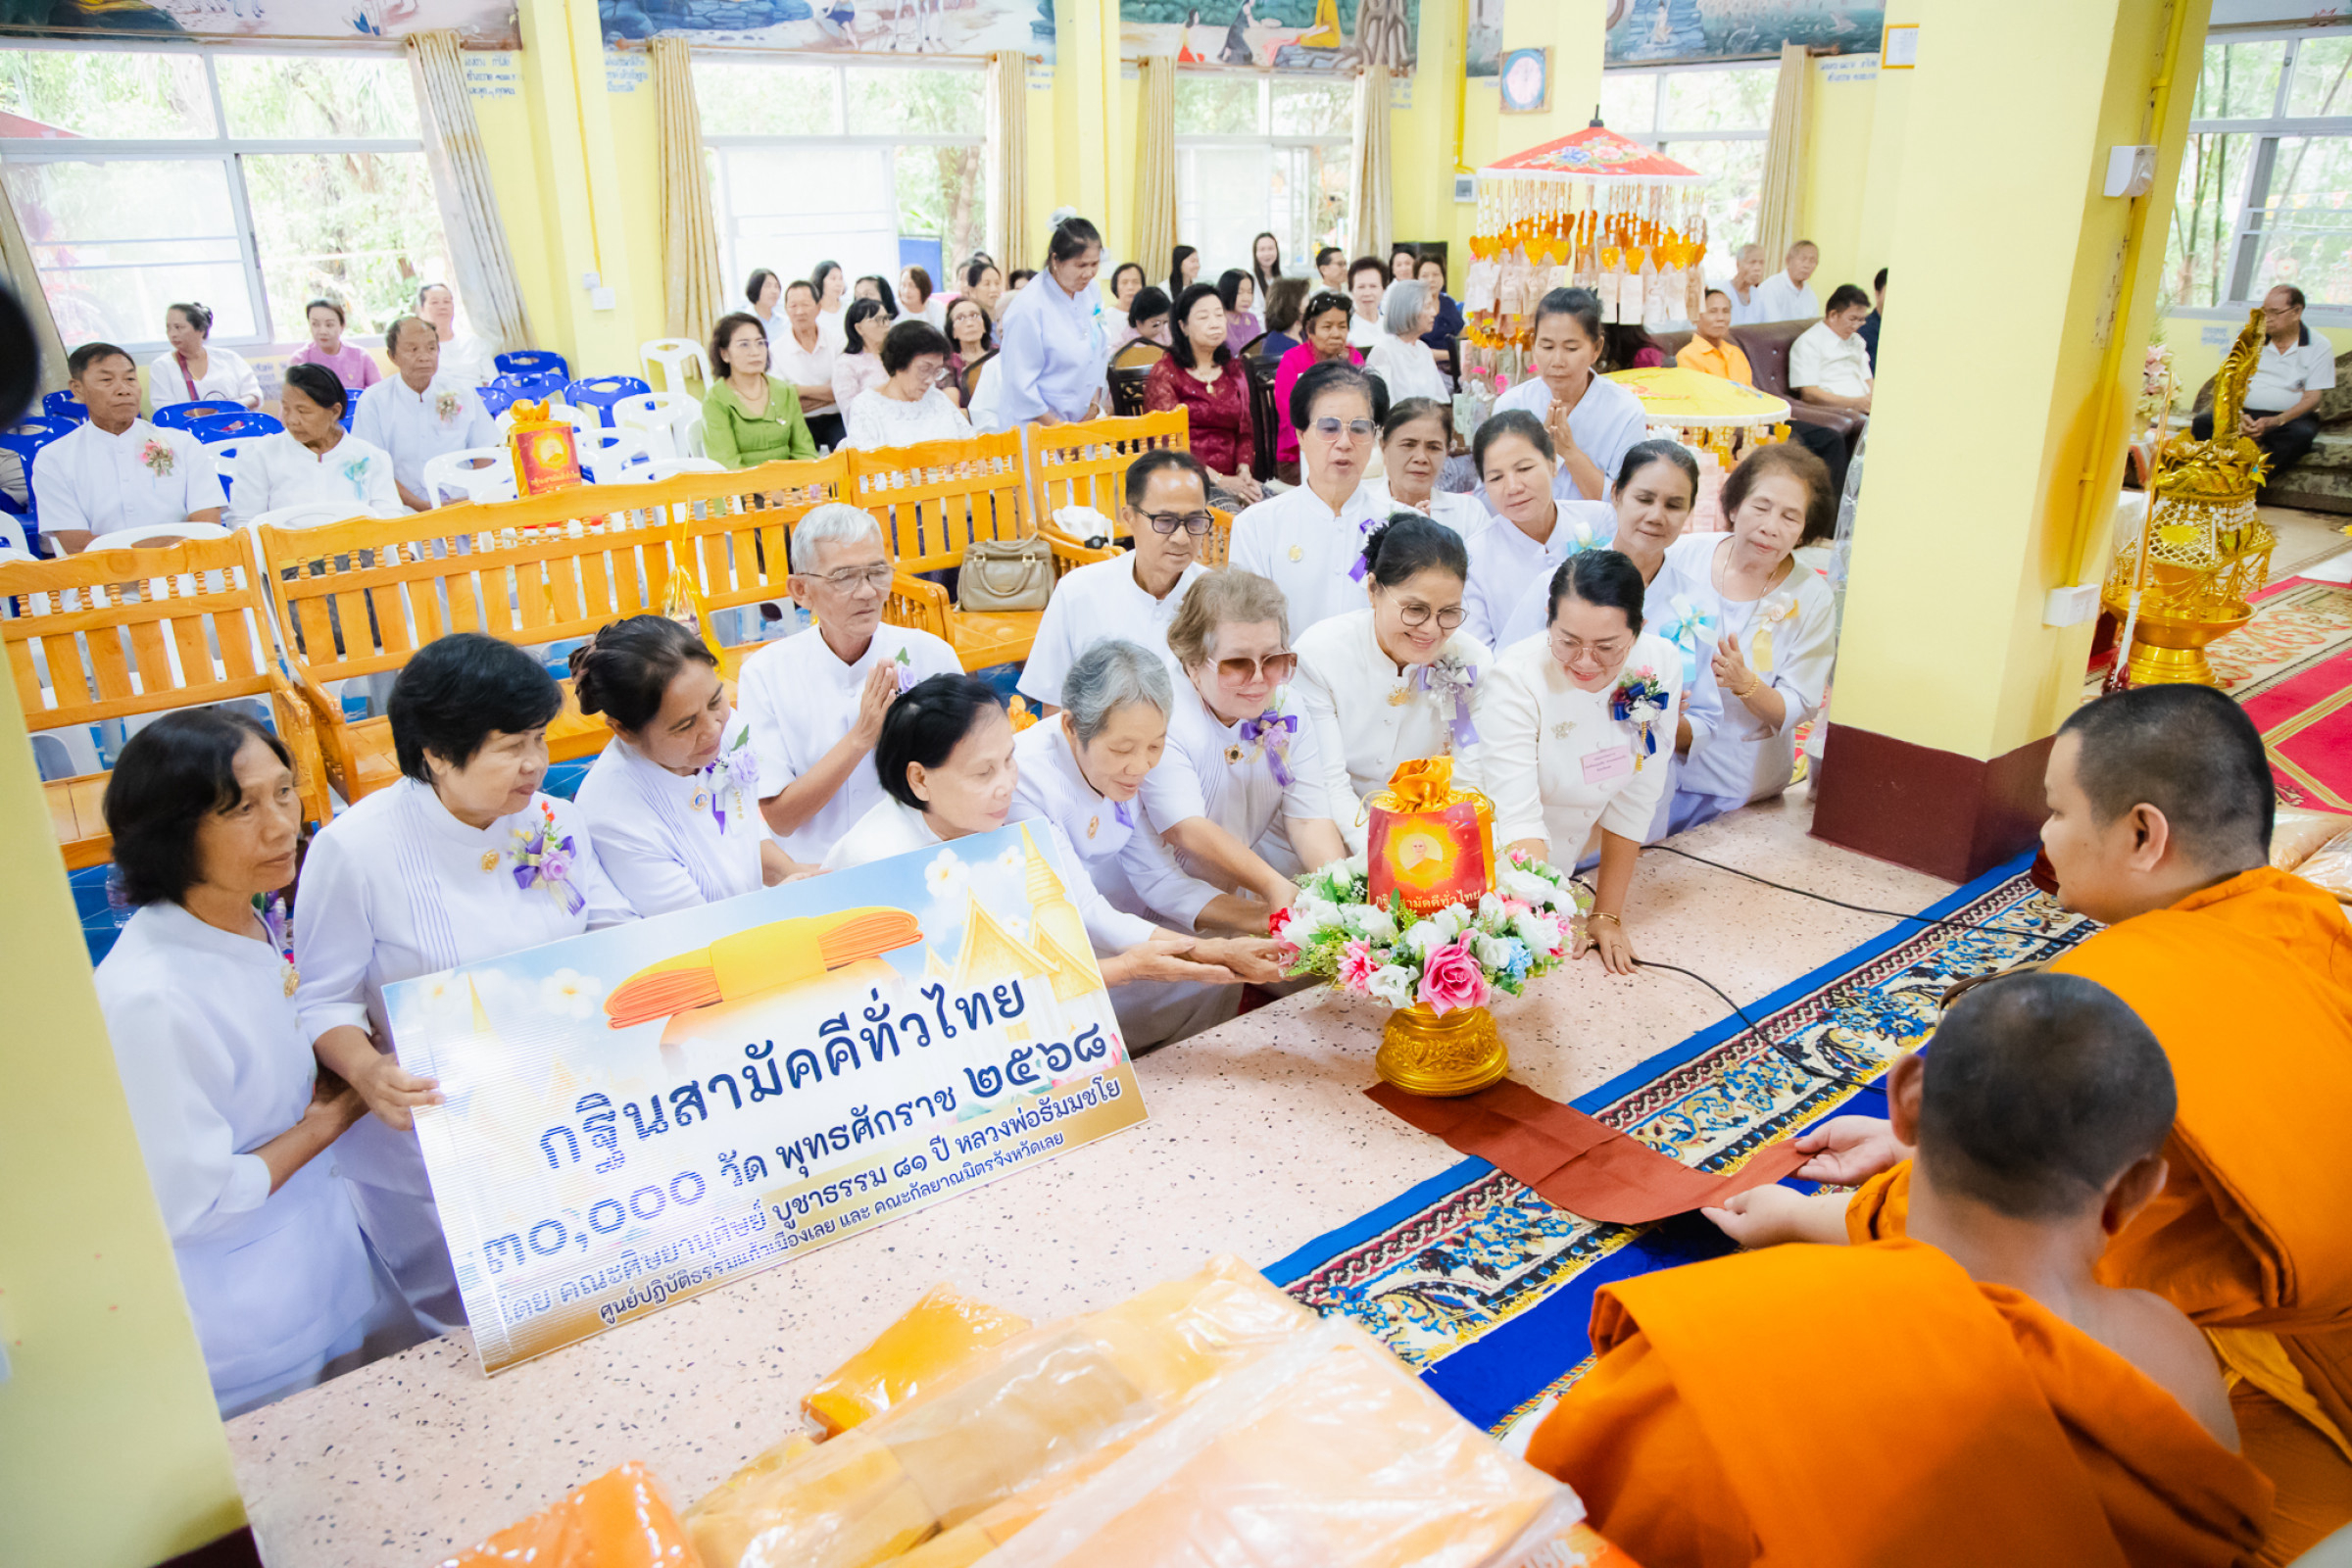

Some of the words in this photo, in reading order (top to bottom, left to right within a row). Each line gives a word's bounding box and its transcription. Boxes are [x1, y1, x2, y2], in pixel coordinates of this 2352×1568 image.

[1375, 889, 1482, 908] กฐิามัคคีทั่วไทย
[539, 978, 1026, 1174] กฐินสามัคคีทั่วไทย
[717, 1150, 767, 1187] วัด
[775, 1085, 956, 1178] พุทธศักราช
[962, 1022, 1106, 1099] ๒๕๖๘
[500, 1290, 552, 1324] โดย
[560, 1198, 767, 1302] คณะศิษยานุศิษย์
[772, 1165, 888, 1229] บูชาธรรม
[893, 1153, 928, 1178] ๘๑
[929, 1135, 951, 1162] ปี
[955, 1075, 1120, 1154] หลวงพ่อธัมมชโย
[600, 1218, 836, 1324] ศูนย์ปฏิบัติธรรมแก้วเมืองเลย
[839, 1206, 871, 1228] และ
[874, 1131, 1064, 1215] คณะกัลยาณมิตรจังหวัดเลย
